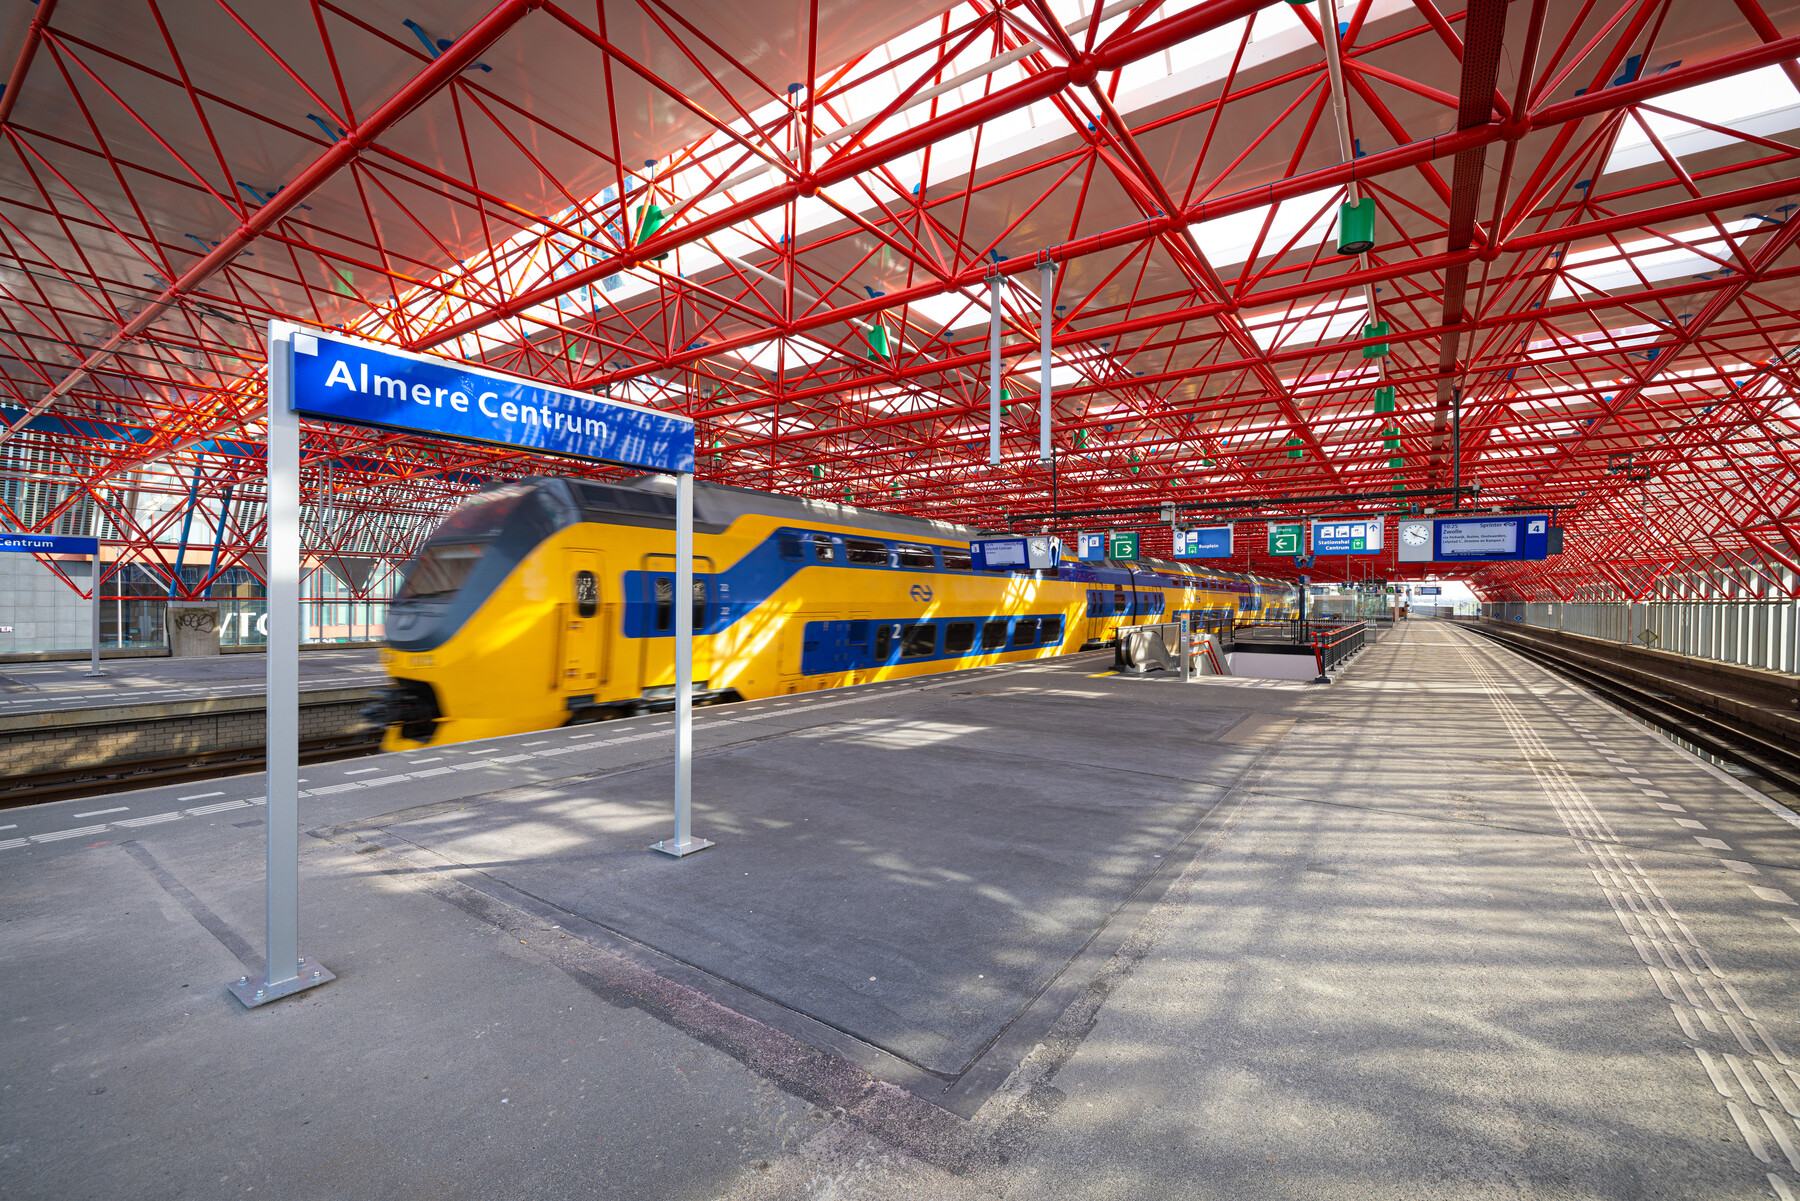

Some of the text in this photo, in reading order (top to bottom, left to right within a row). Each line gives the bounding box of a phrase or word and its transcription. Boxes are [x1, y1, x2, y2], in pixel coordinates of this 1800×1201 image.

[325, 360, 607, 439] Almere Centrum
[890, 554, 900, 568] 2
[1036, 618, 1042, 629] 2
[892, 624, 901, 638] 2
